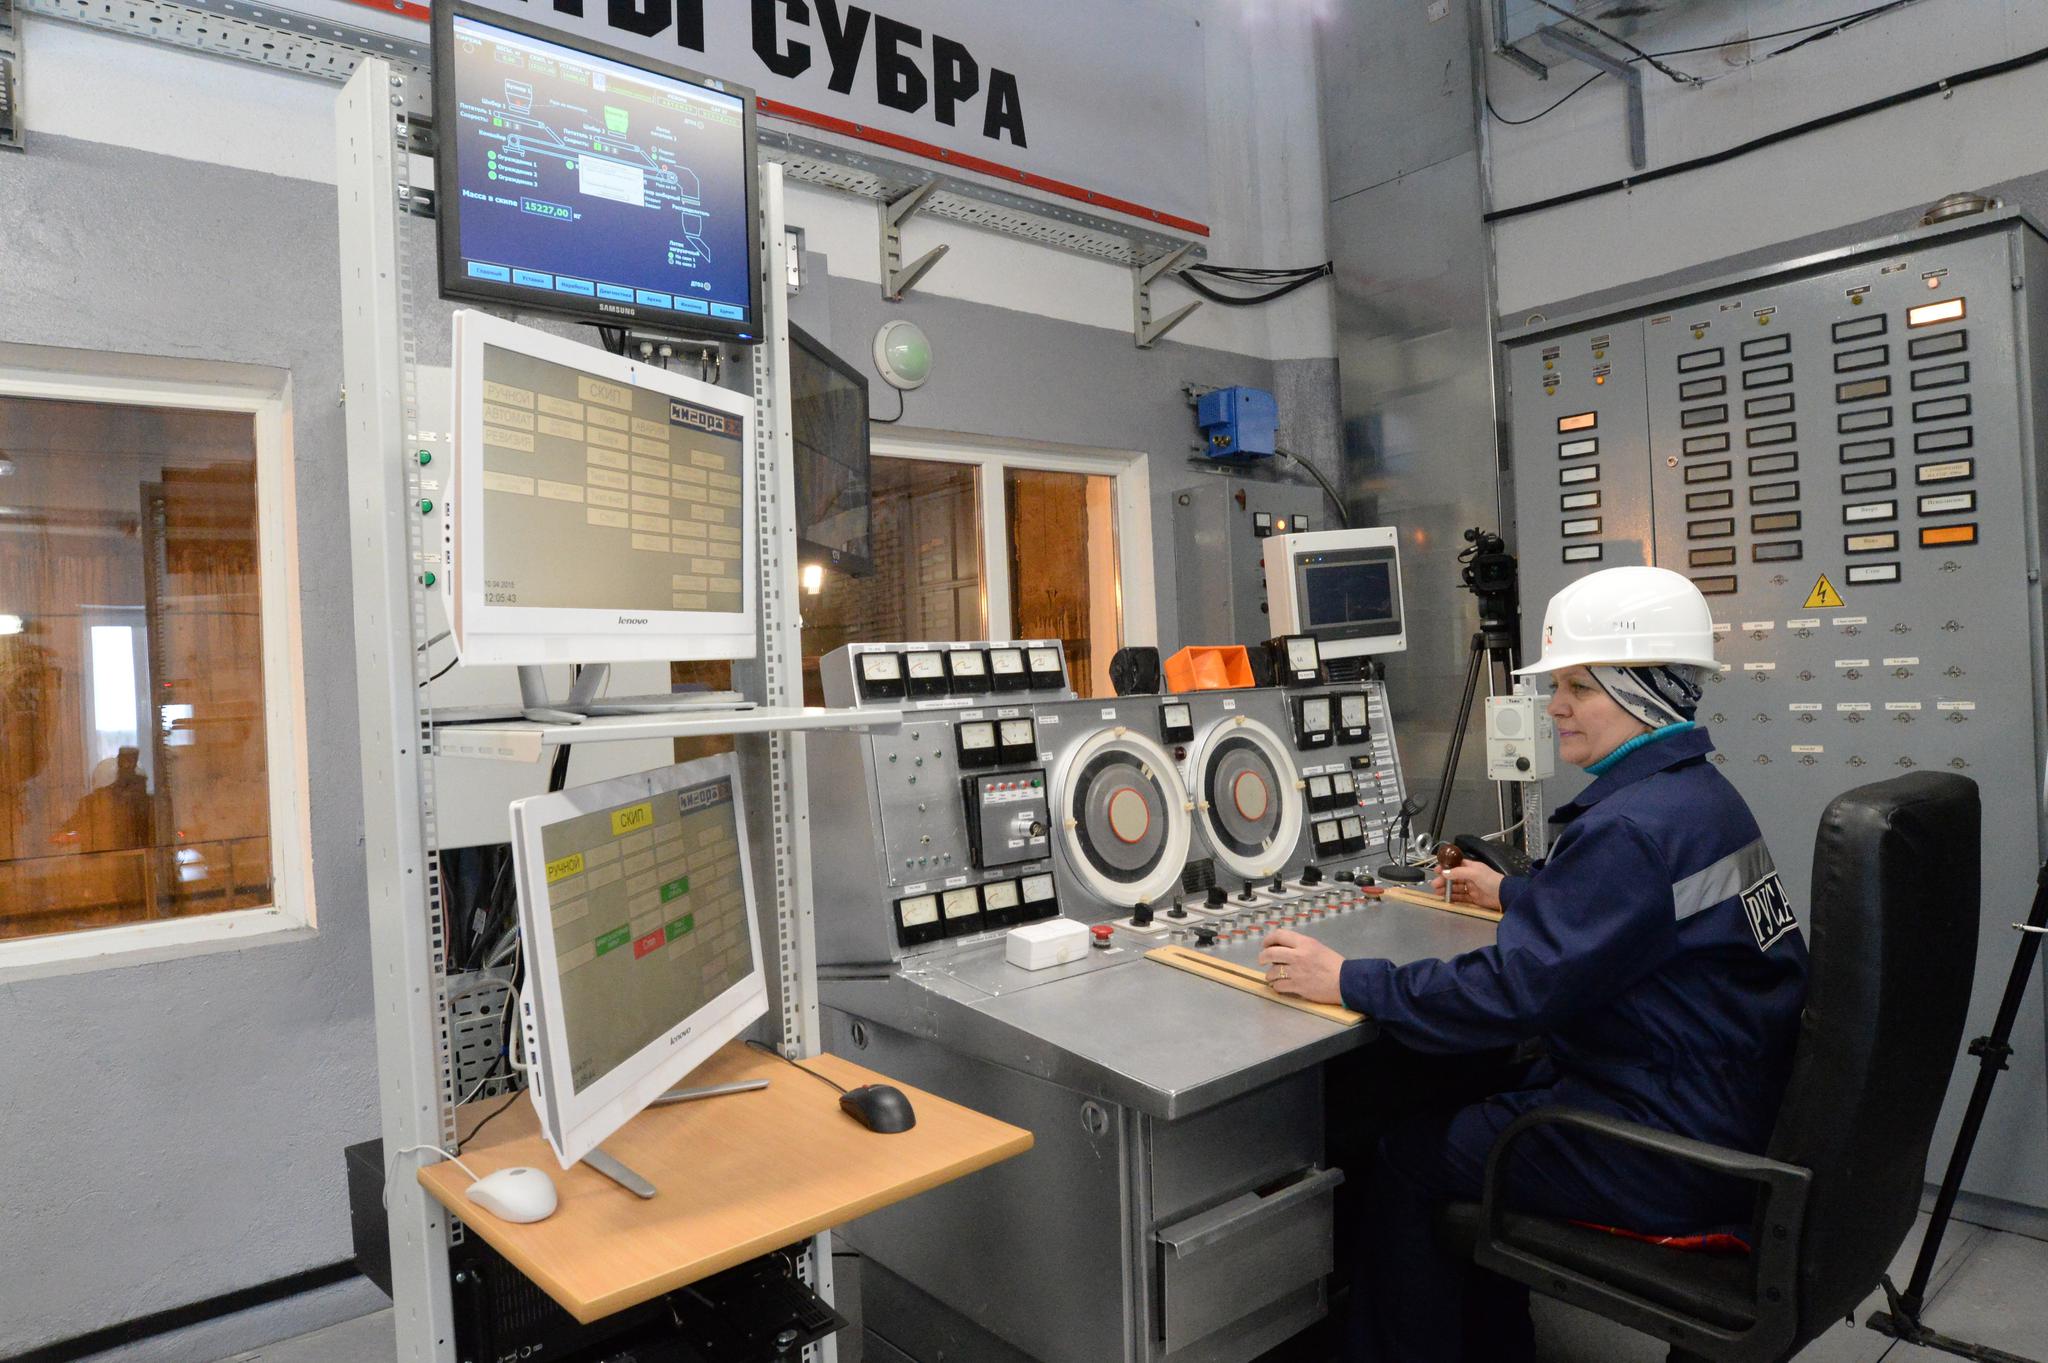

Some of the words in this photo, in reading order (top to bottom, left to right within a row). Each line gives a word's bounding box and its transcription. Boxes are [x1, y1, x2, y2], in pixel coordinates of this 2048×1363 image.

[752, 0, 1028, 149] СУБРА
[462, 189, 487, 201] Масса
[495, 196, 518, 207] скипе
[524, 201, 569, 219] 15227,00
[573, 212, 582, 220] кг
[599, 303, 636, 316] SAMSUNG
[487, 384, 531, 406] РУЧНОЙ
[590, 382, 622, 403] СКИП
[485, 406, 532, 426] АВТОМАТ
[485, 429, 533, 447] РЕВИЗИЯ
[618, 616, 649, 626] lenovo
[620, 808, 644, 828] СКИП
[547, 856, 581, 877] РУЧНОЙ
[670, 1026, 692, 1046] lenovo
